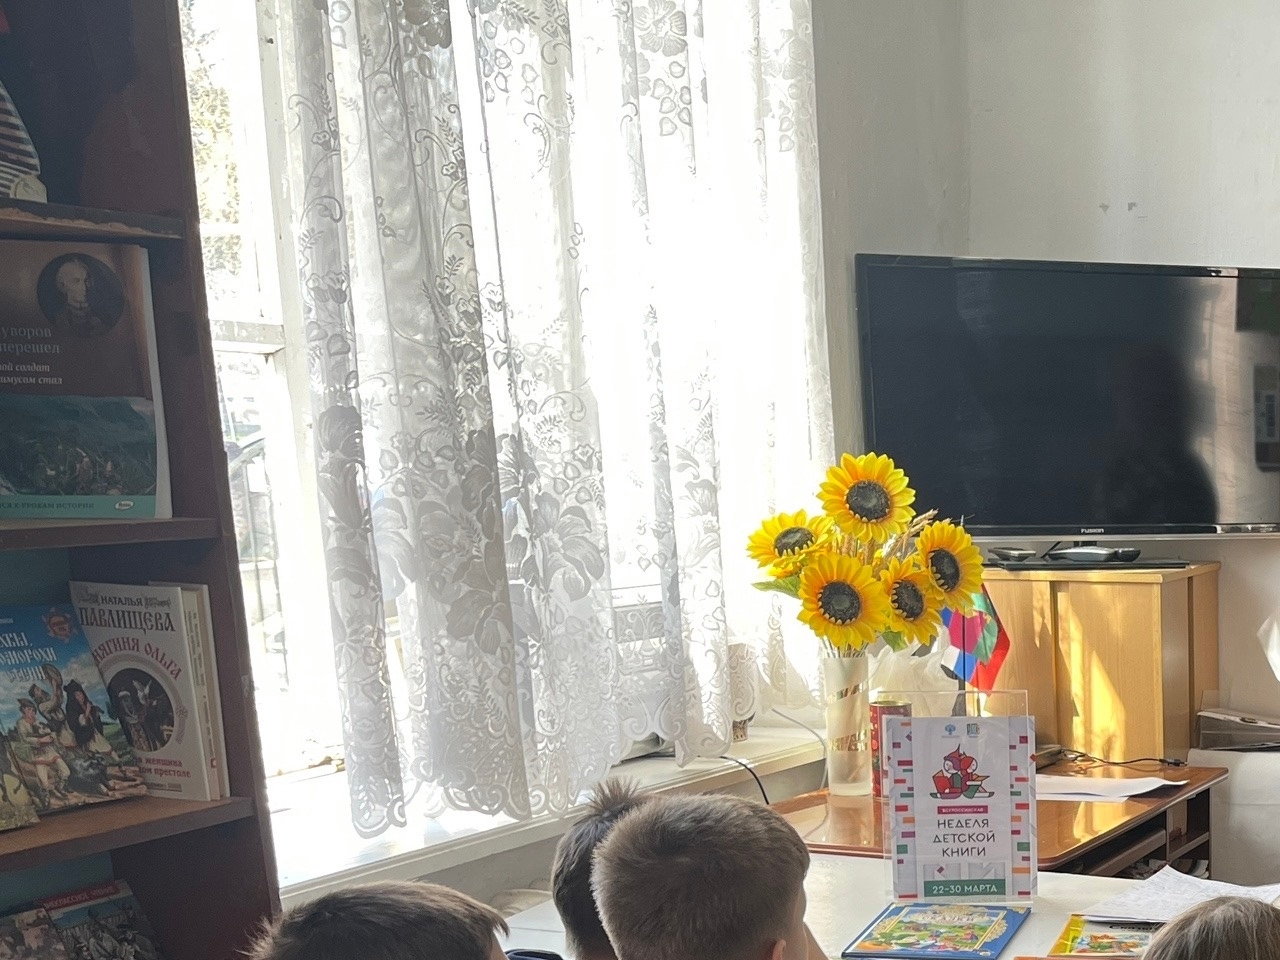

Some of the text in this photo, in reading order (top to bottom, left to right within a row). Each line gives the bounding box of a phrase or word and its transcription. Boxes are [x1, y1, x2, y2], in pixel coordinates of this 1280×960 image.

[100, 595, 144, 607] НАТАЛЬЯ
[79, 607, 176, 635] ПАВЛИЩЕВА
[92, 637, 183, 681] НЯГИНЯ ОЛЬГА
[937, 818, 989, 829] НЕДЕЛЯ
[933, 830, 995, 844] ДЕТСКОЙ
[942, 847, 986, 857] КНИГИ
[964, 884, 998, 893] МАРТА
